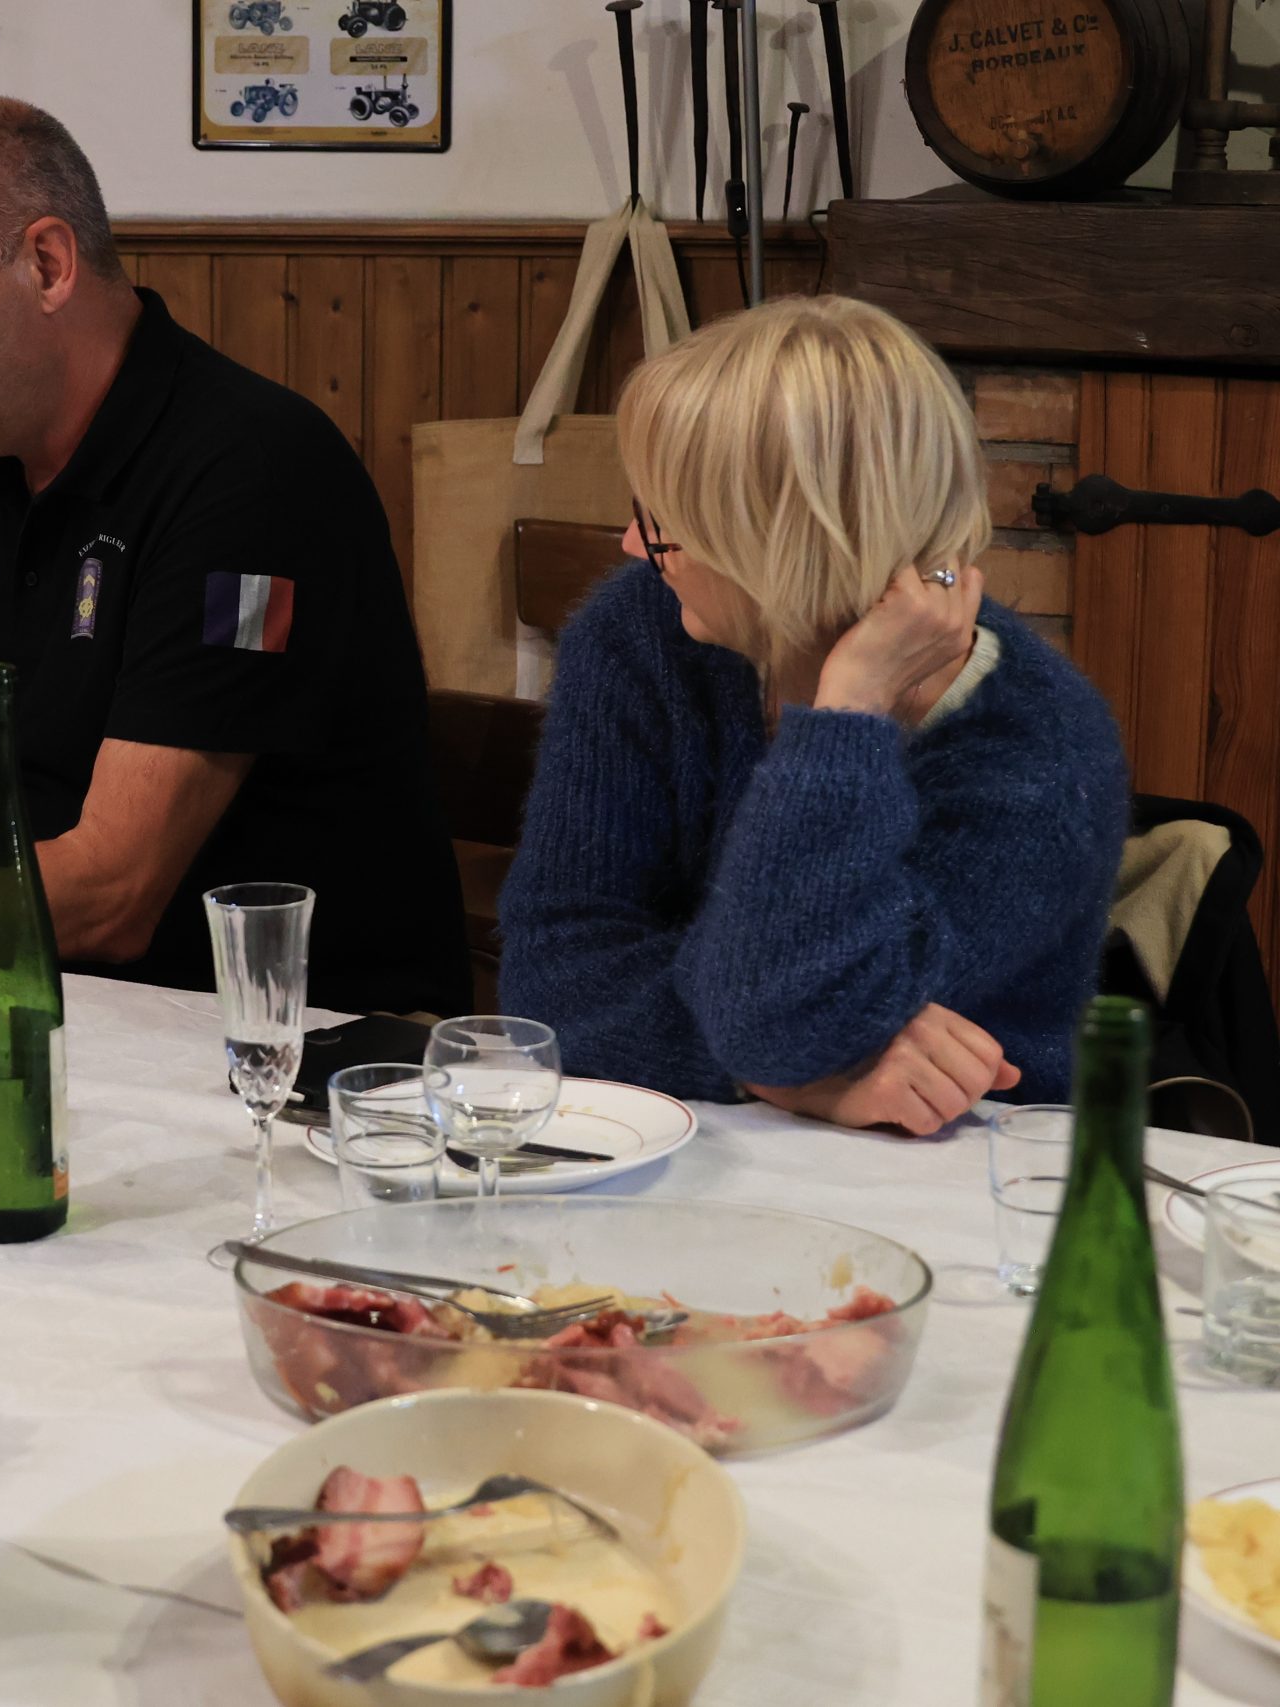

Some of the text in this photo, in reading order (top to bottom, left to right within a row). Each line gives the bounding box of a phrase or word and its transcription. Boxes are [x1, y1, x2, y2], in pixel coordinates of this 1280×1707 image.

[949, 33, 965, 52] J.
[970, 20, 1045, 50] CALVET
[1051, 17, 1068, 36] &
[972, 44, 1086, 73] BORDEAUX
